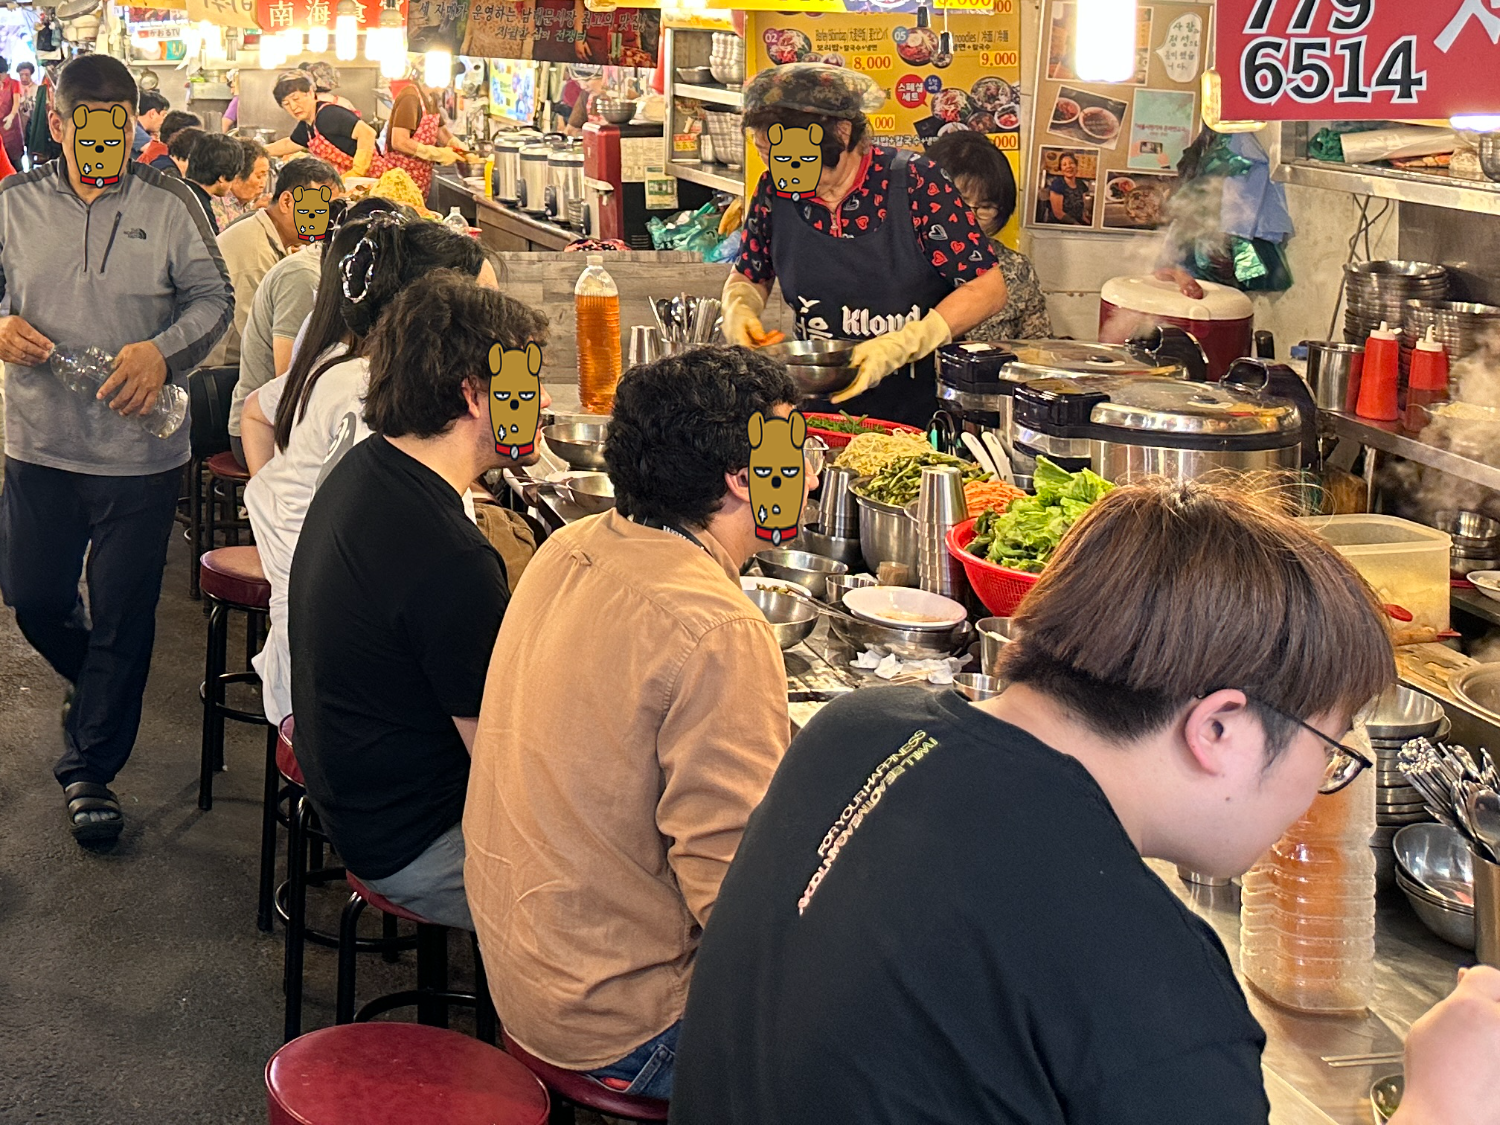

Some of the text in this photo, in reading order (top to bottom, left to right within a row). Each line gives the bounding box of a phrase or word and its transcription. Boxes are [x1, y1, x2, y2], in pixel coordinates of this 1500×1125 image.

[472, 5, 517, 24] 운영하는
[765, 32, 778, 43] 02
[894, 31, 907, 42] 05
[853, 55, 891, 70] 8.000
[981, 52, 1017, 67] 9.000
[1242, 36, 1427, 105] 6514
[898, 82, 924, 93] 스페셜
[902, 91, 919, 102] 세트
[817, 729, 927, 857] FOR YOUR HAPPINESS
